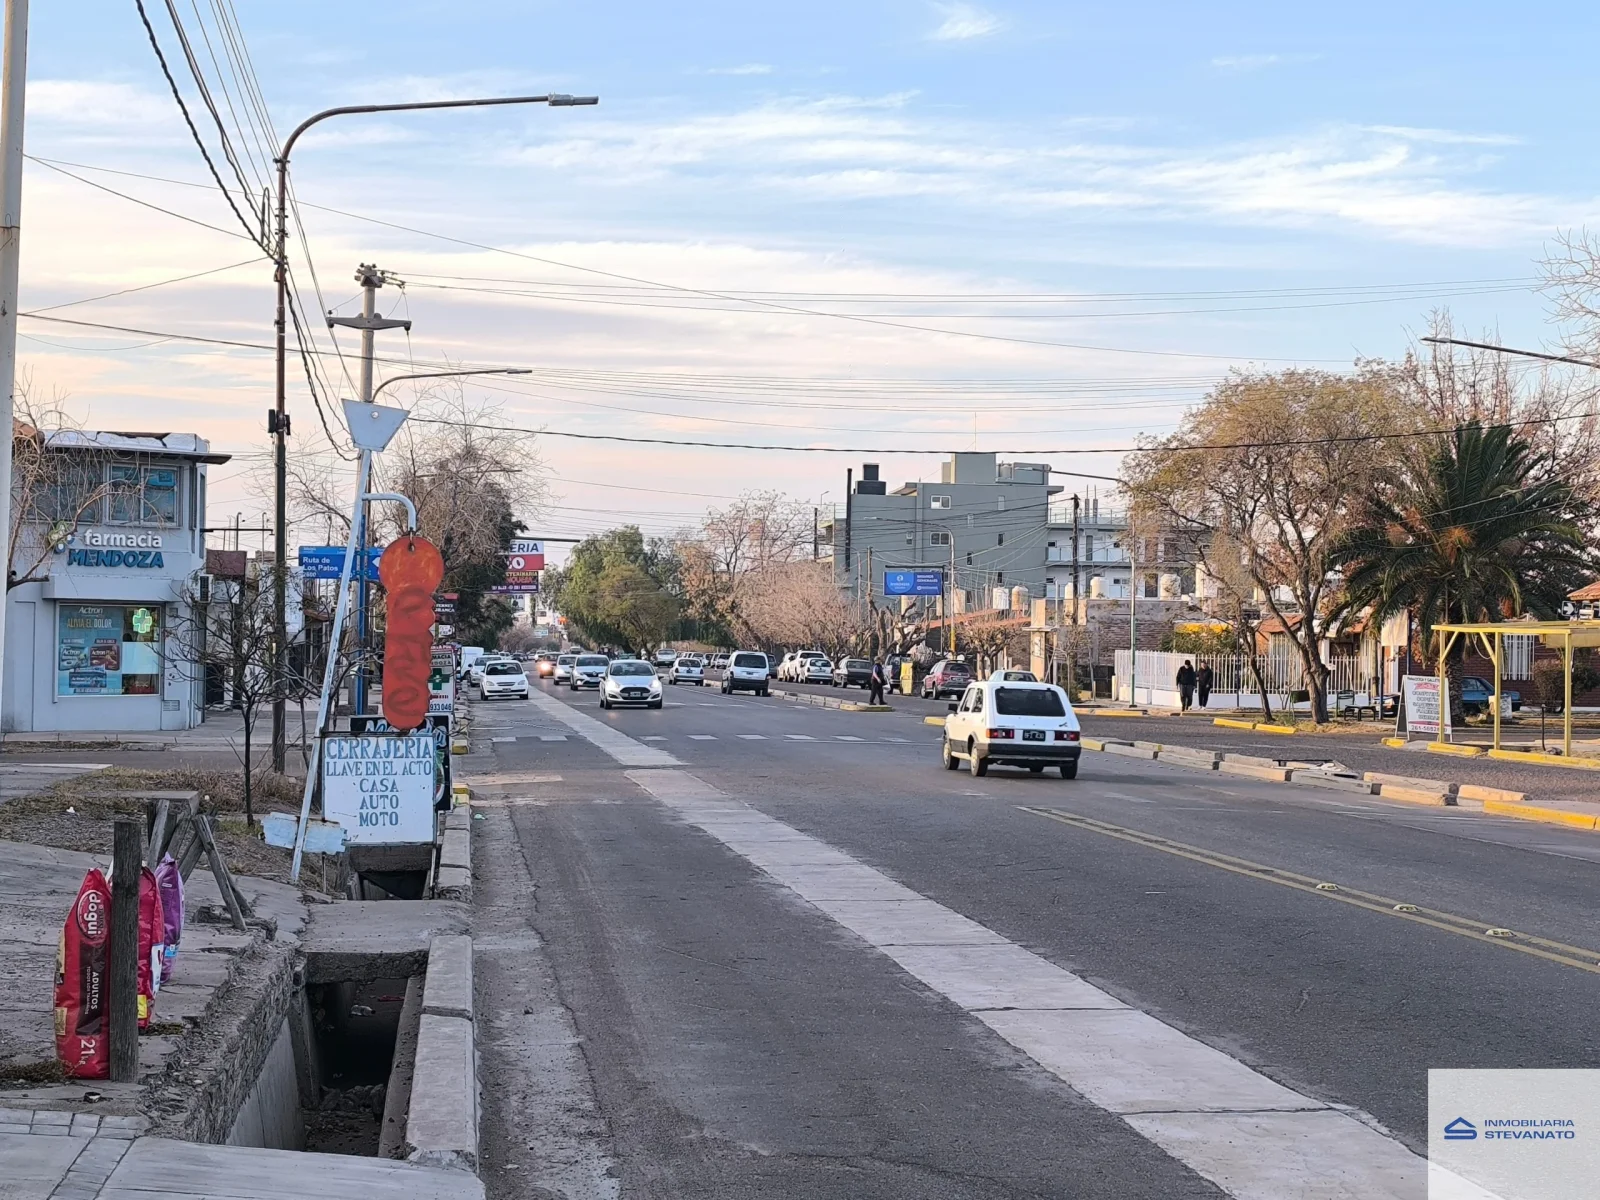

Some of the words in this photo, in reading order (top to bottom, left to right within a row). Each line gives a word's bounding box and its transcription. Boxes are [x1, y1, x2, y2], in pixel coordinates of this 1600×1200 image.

[85, 529, 162, 548] farmacia
[510, 543, 538, 552] ERIA
[67, 548, 164, 568] MENDOZA
[78, 606, 103, 614] Actron
[94, 619, 112, 629] DOLOR
[326, 738, 432, 759] CERRAJERIA
[326, 761, 362, 776] LLAVE
[365, 761, 381, 776] EN
[383, 761, 397, 775] EL
[402, 760, 432, 775] ACTO
[359, 778, 399, 793] CASA
[359, 795, 399, 810] AUTO
[358, 811, 399, 827] MOTO
[83, 893, 101, 935] dogui
[91, 972, 99, 1010] ADULTOS
